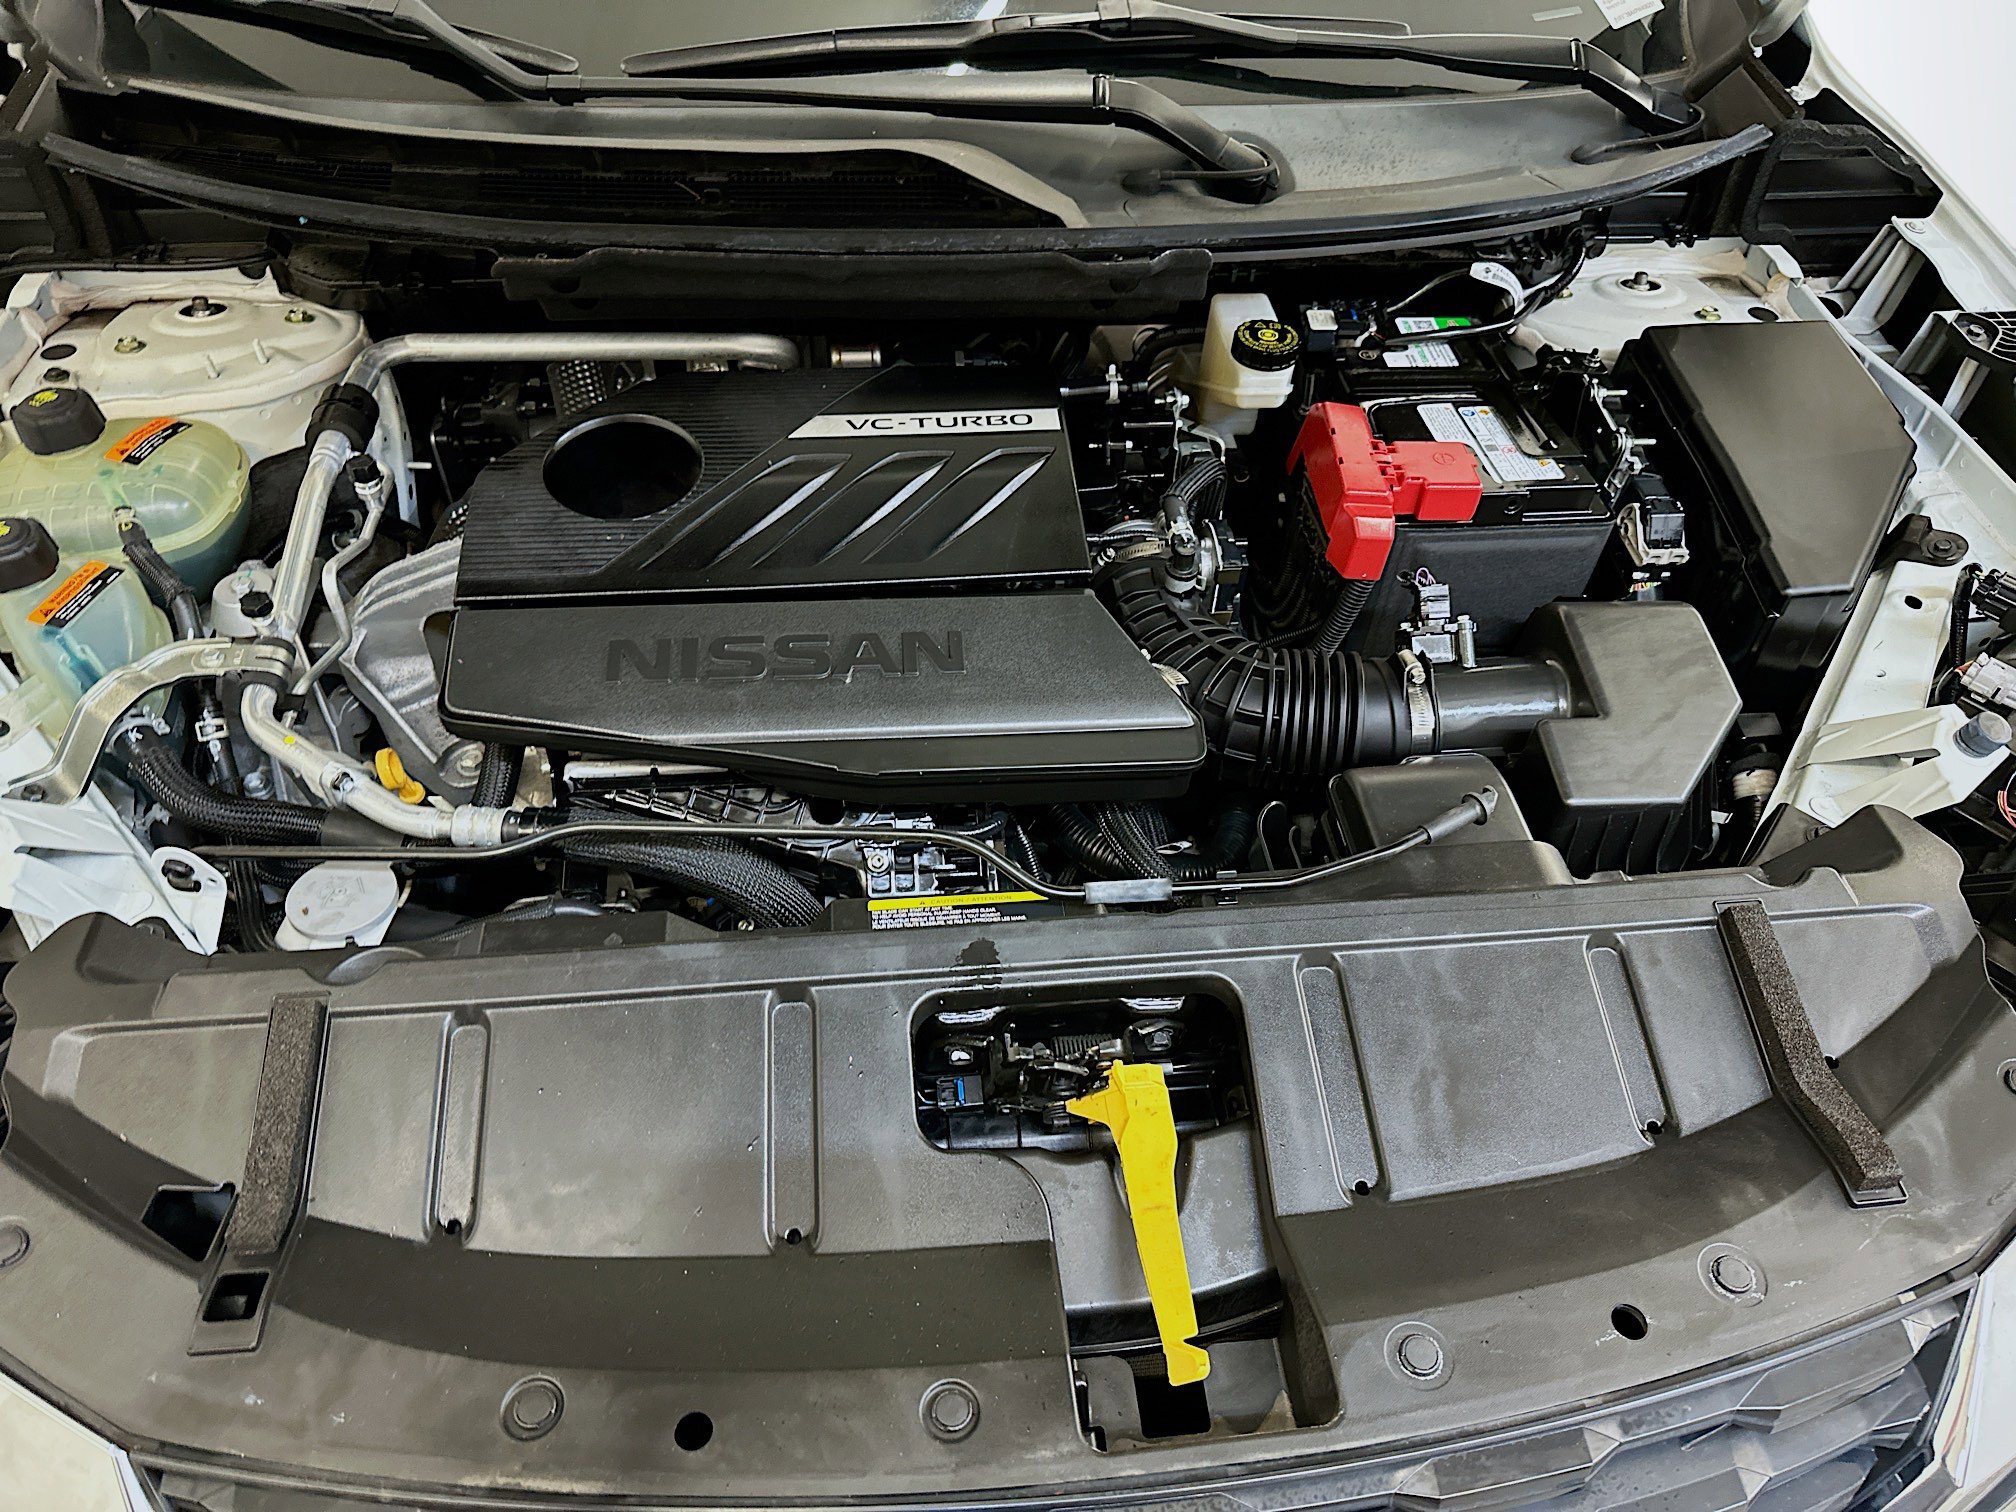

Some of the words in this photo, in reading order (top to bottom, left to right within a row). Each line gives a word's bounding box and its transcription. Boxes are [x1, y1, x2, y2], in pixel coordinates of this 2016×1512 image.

[846, 413, 1033, 430] VC-TURBO
[605, 631, 966, 683] NISSAN
[930, 897, 963, 905] CAUTION
[972, 894, 1012, 902] ATTENTION
